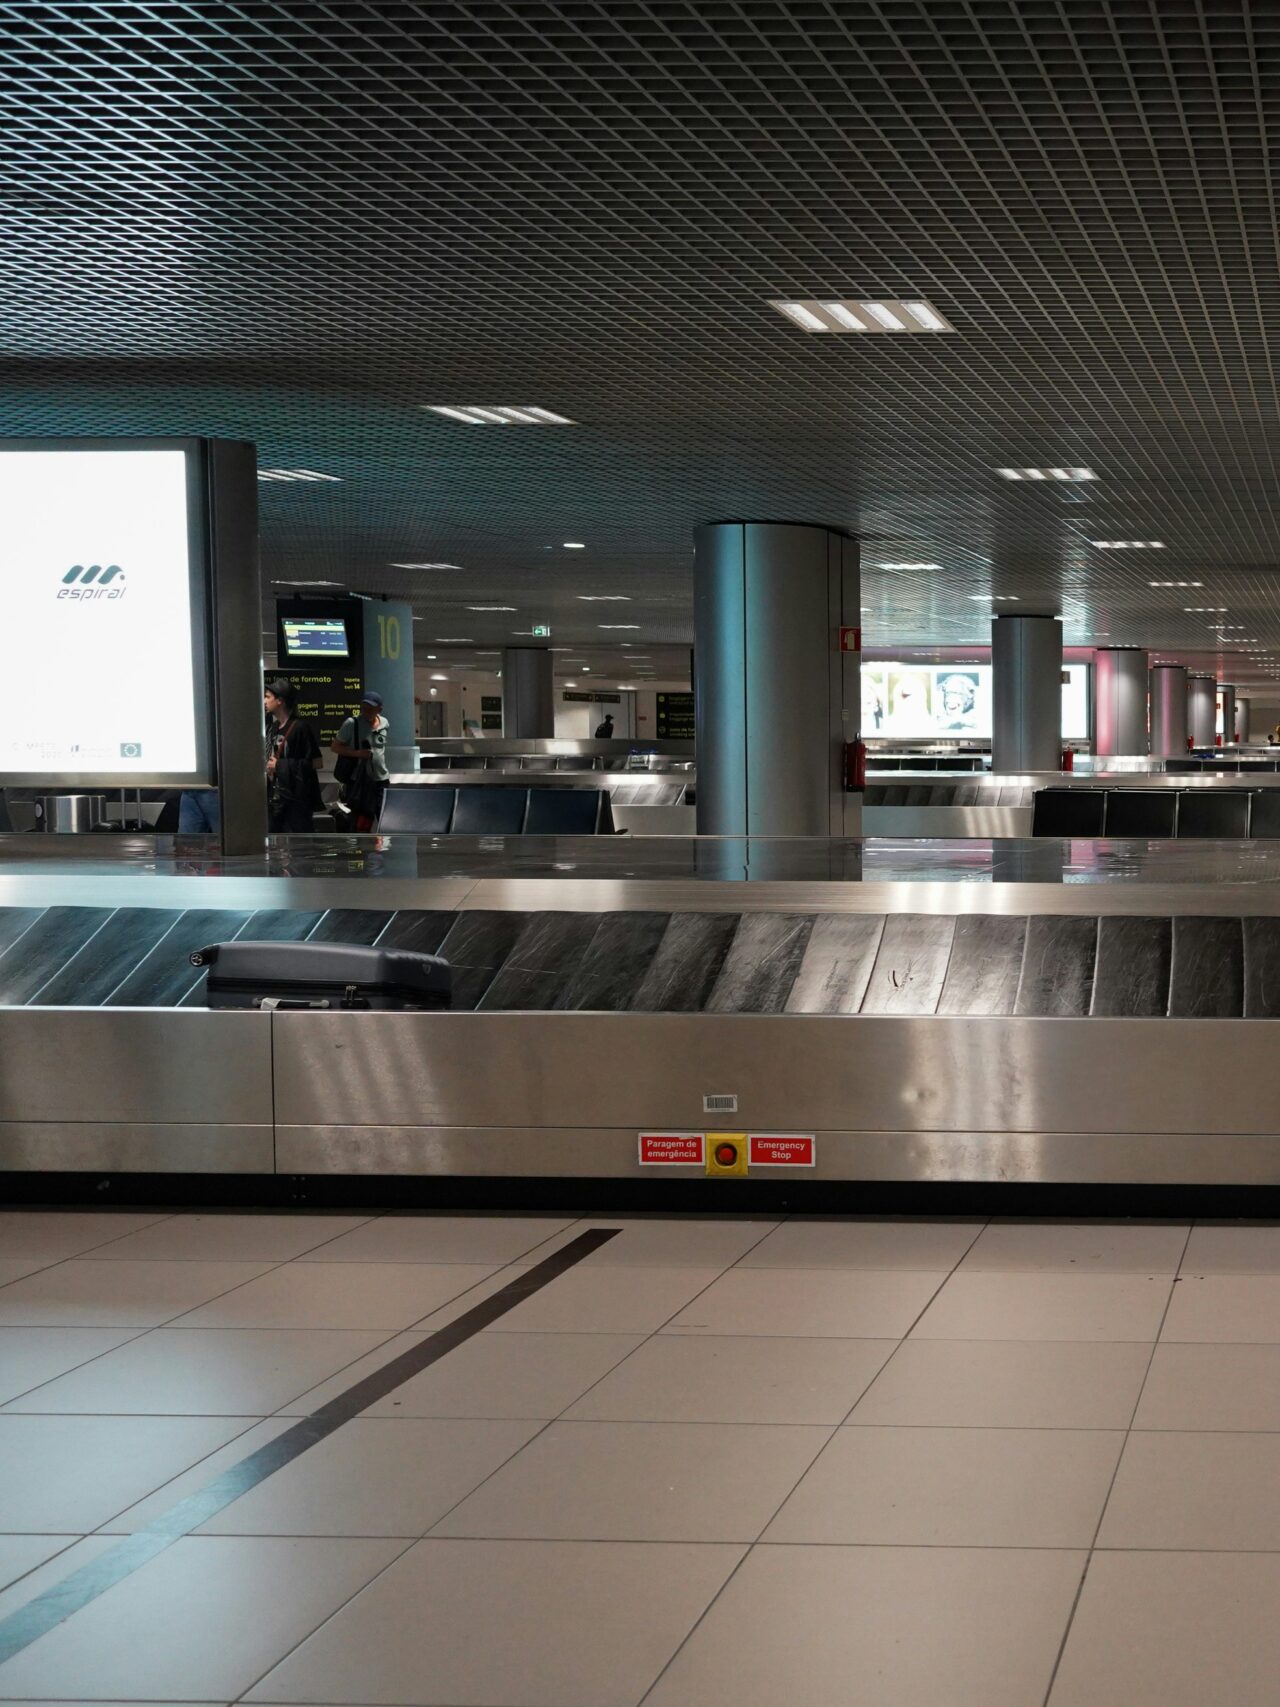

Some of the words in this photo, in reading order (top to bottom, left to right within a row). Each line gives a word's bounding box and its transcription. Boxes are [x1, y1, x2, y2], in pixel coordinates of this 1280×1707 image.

[56, 586, 127, 602] espiral
[377, 614, 400, 659] 10
[647, 1139, 684, 1149] Paragem
[686, 1140, 697, 1148] de
[757, 1141, 806, 1151] Emergency
[647, 1149, 697, 1159] emergência
[771, 1150, 792, 1160] Stop
